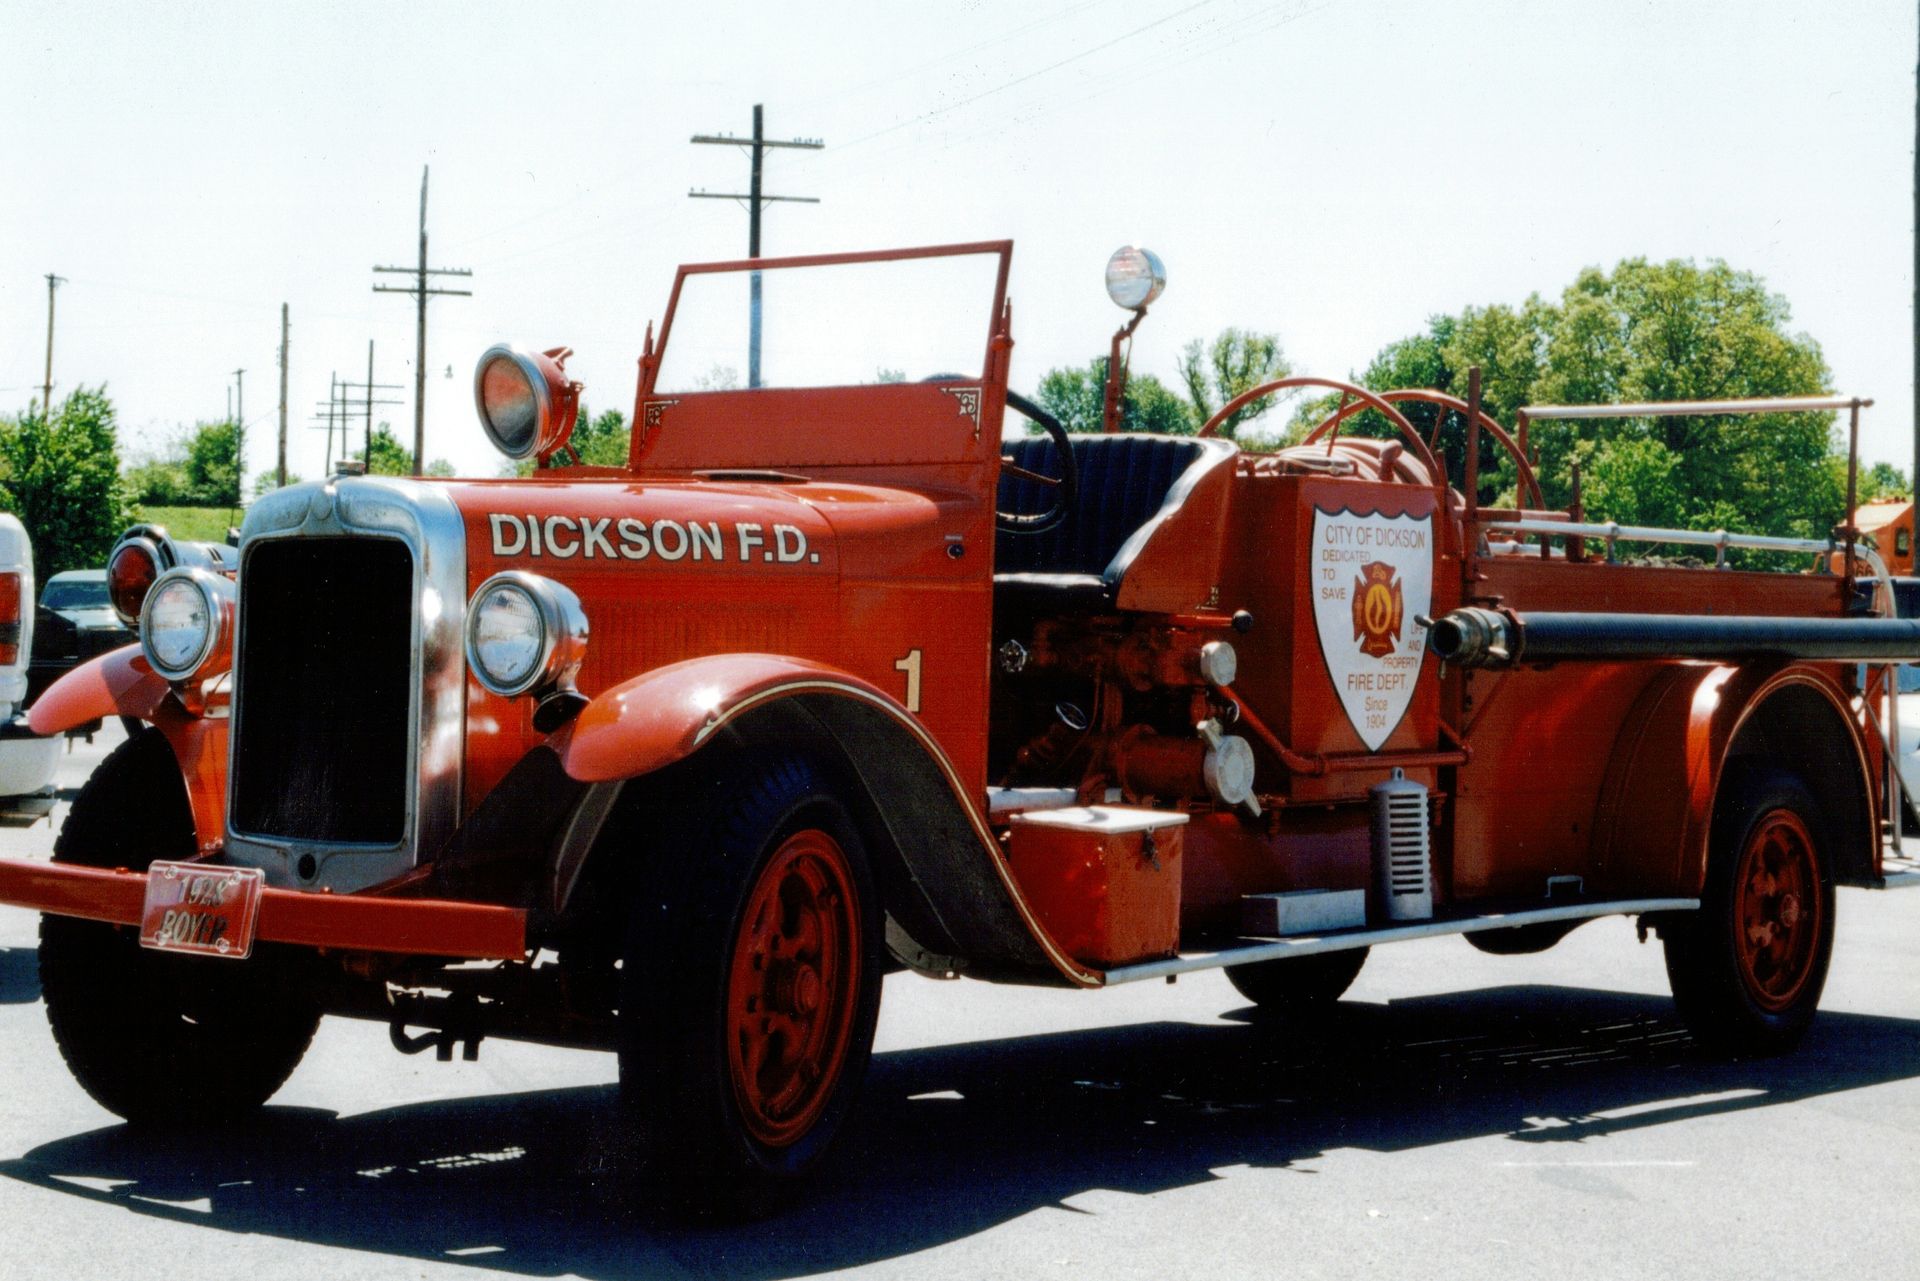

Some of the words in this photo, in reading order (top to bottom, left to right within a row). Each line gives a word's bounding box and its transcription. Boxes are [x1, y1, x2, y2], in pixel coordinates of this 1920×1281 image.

[489, 512, 723, 561] DICKSON
[737, 522, 819, 563] F.D.
[1325, 524, 1352, 544] CITY
[1356, 526, 1372, 545] OF
[1376, 527, 1425, 549] DICKSON
[1322, 549, 1371, 563] DEDICATED
[1322, 568, 1336, 580] TO
[1321, 587, 1346, 600] SAVE
[1408, 640, 1421, 651] AND
[1383, 656, 1419, 669] PROPERTY
[895, 649, 923, 714] 1
[1347, 673, 1374, 691] FIRE
[1364, 695, 1388, 712] Since
[1366, 715, 1386, 729] 1904
[178, 874, 228, 907] 1928
